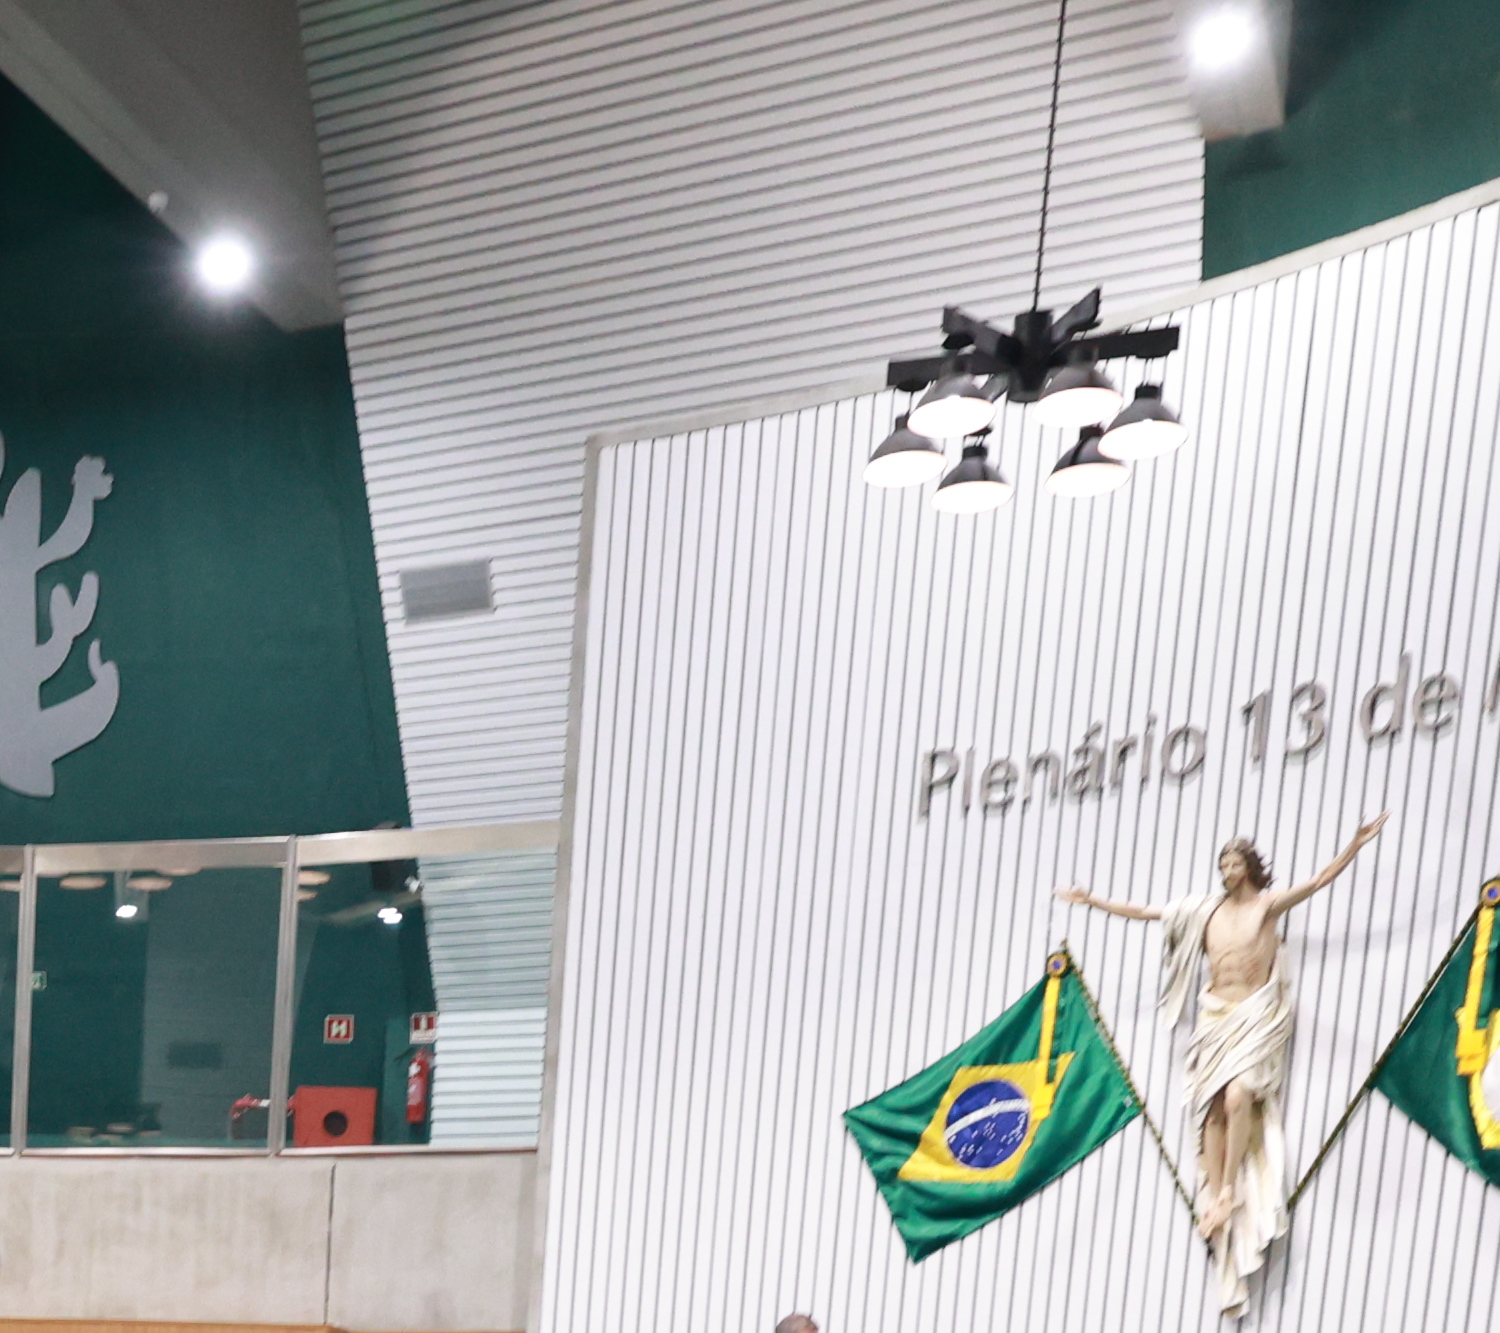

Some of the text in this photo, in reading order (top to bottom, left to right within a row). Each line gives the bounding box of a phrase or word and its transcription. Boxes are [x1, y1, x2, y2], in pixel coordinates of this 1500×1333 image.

[918, 711, 1206, 822] Plenário
[1241, 681, 1327, 765] 13
[1359, 651, 1461, 742] de
